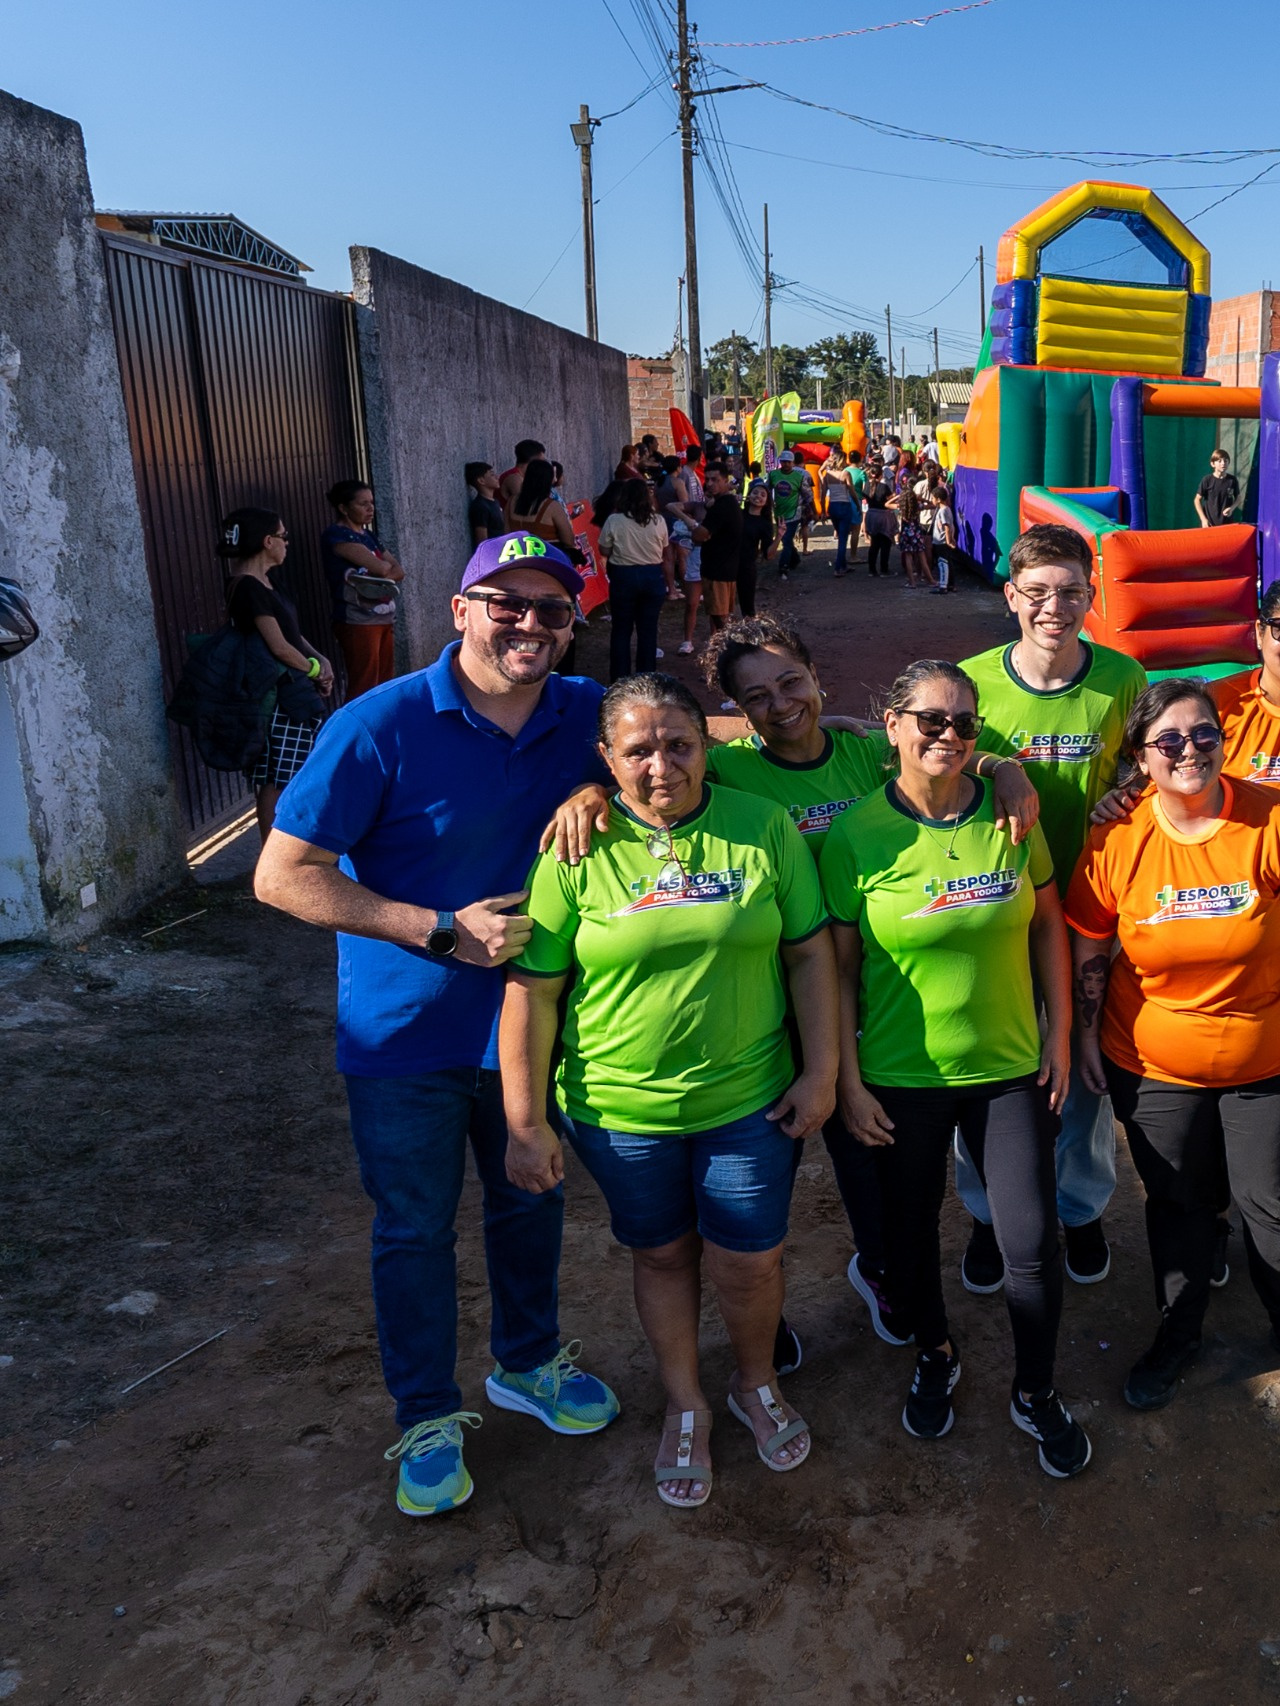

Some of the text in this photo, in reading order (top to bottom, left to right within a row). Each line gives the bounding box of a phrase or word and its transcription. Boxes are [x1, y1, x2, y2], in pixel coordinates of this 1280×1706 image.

[1032, 734, 1100, 746] ESPORTE
[1029, 747, 1051, 755] PARA
[807, 797, 862, 817] ESPO
[808, 817, 831, 826] PARA
[947, 869, 1017, 892] ESPORTE
[946, 886, 1003, 902] PARA TODOS
[1177, 882, 1249, 902] ESPORTE
[1174, 899, 1231, 912] PARA TODOS
